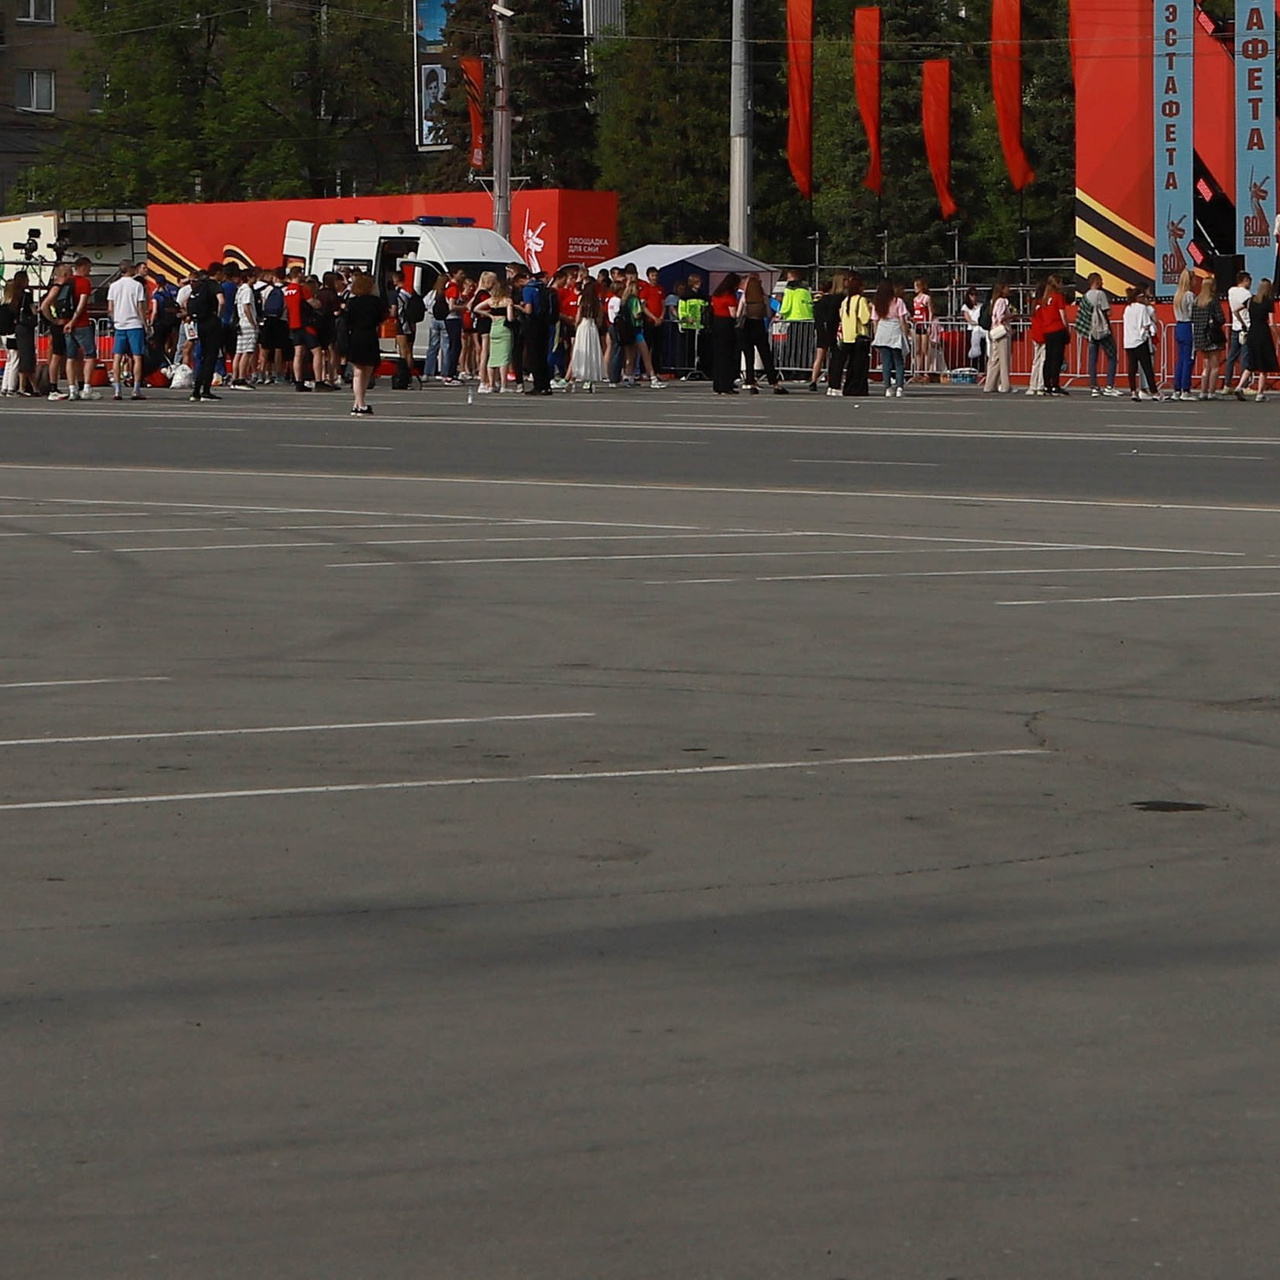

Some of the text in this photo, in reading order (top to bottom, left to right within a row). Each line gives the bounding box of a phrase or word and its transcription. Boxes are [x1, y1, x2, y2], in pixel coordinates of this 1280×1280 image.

[1161, 4, 1181, 190] ЭСТАФЕТА
[1244, 215, 1258, 234] 80
[568, 237, 609, 246] ПЛОЩАДКА
[568, 245, 582, 253] ДЛЯ
[1162, 253, 1176, 272] 80
